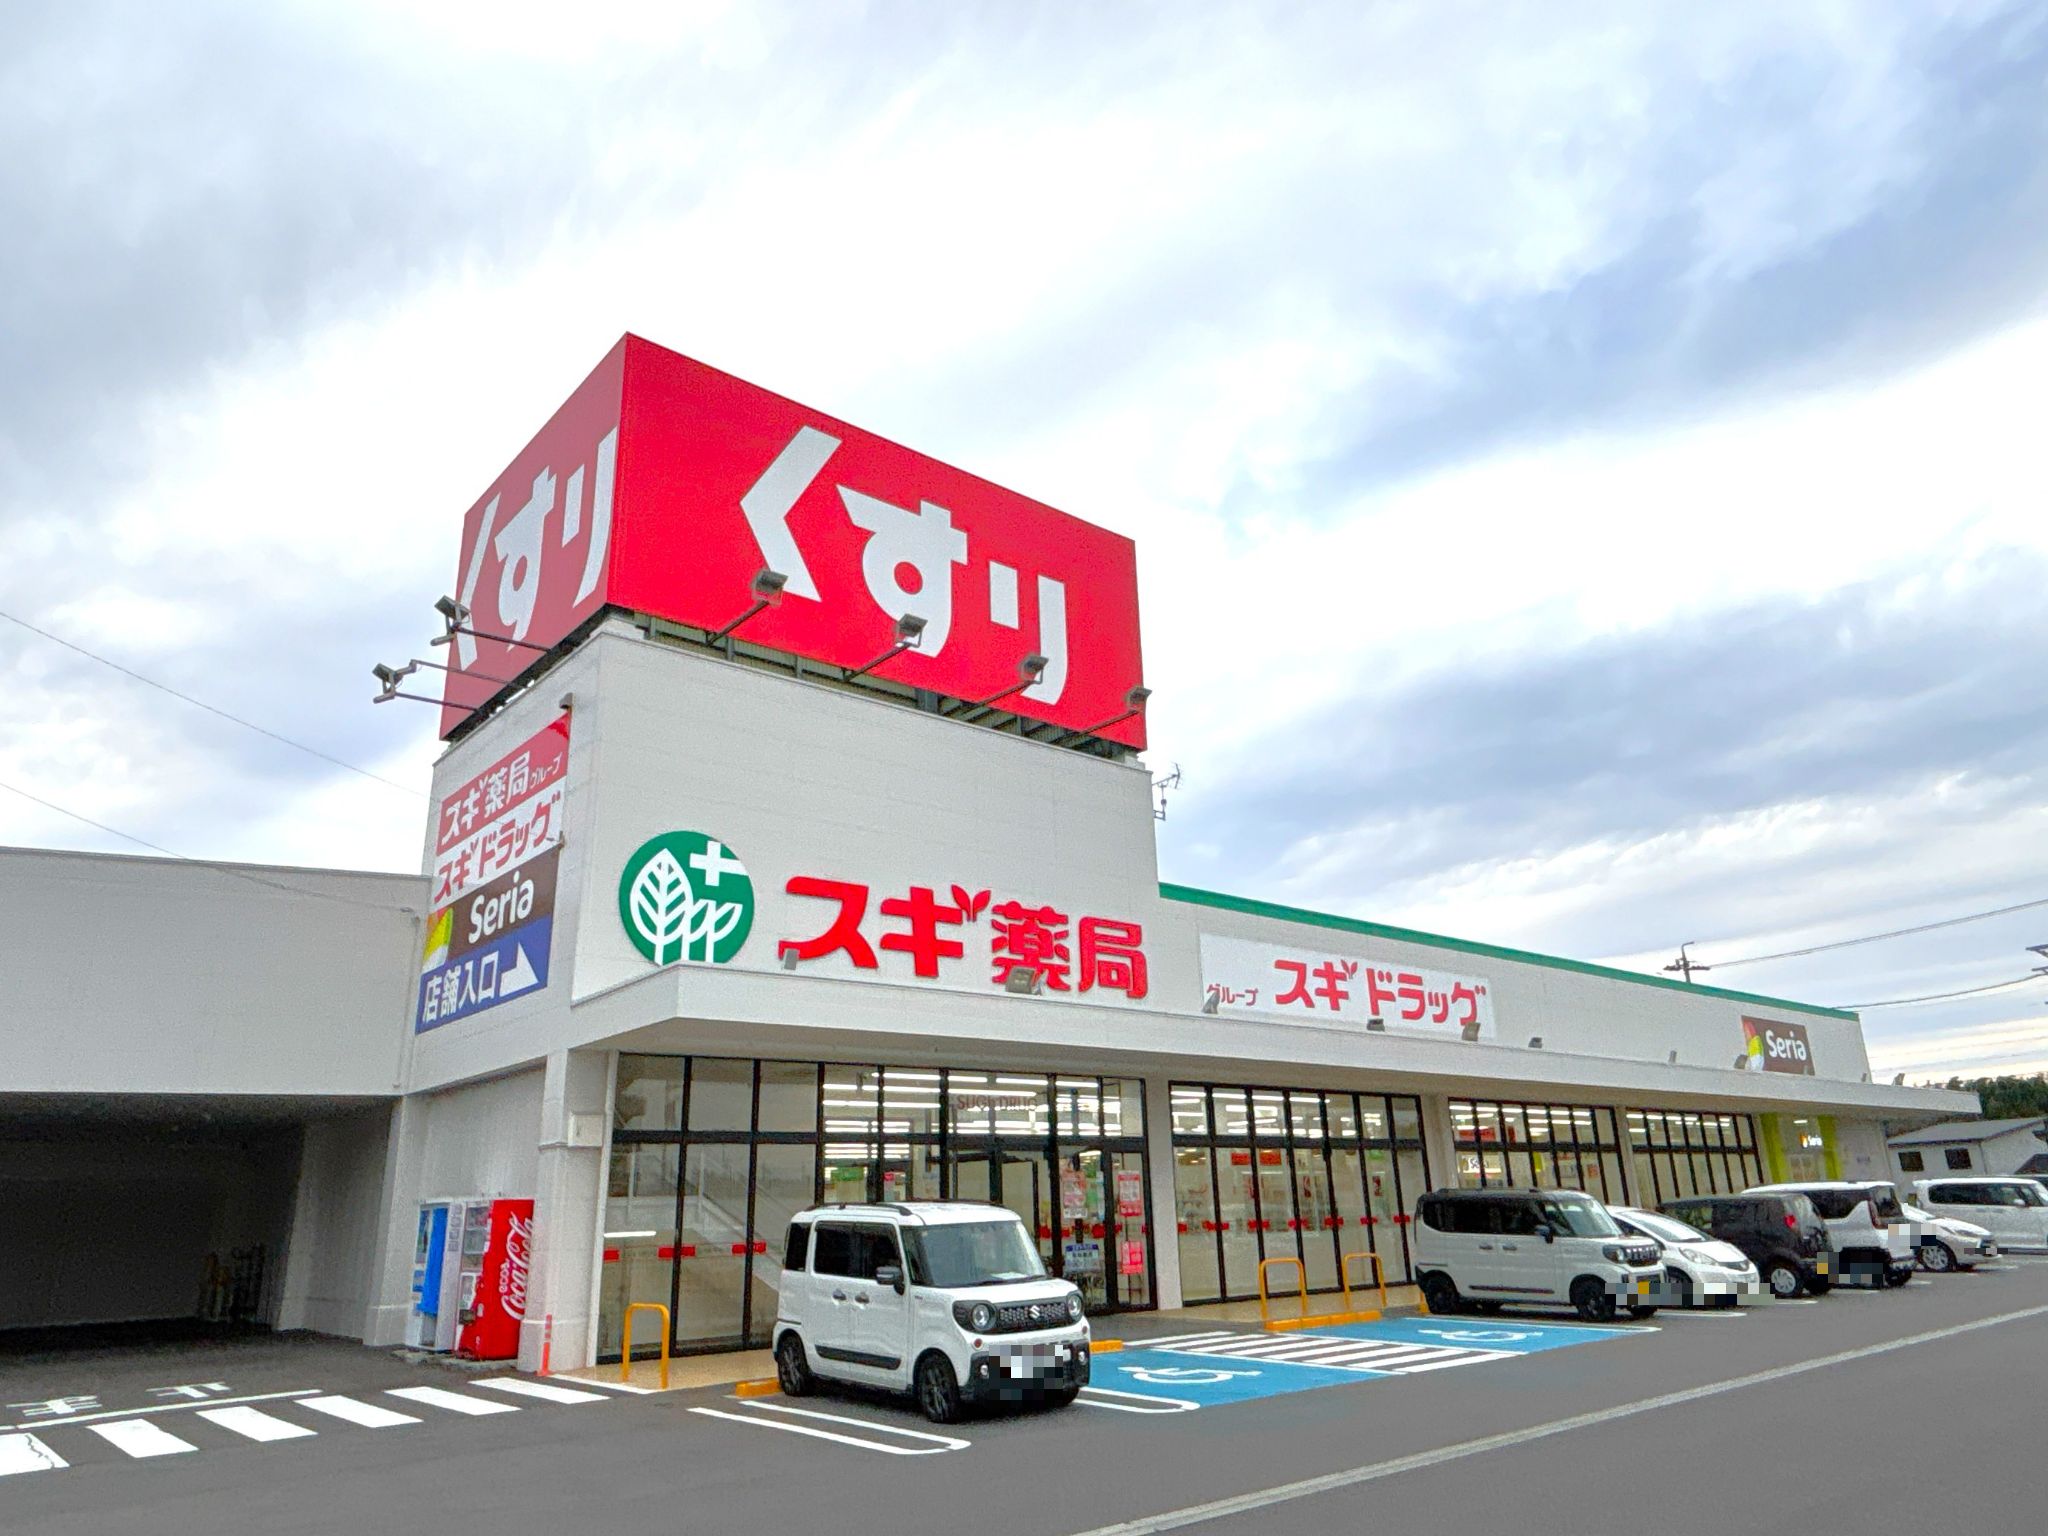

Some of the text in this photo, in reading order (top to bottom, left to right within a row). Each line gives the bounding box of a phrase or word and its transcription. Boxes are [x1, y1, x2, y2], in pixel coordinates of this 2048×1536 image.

[455, 425, 618, 671] くすり
[740, 424, 1068, 706] くすり
[441, 751, 531, 846] スギ薬局
[434, 790, 561, 904] スギドラッグ
[469, 870, 534, 944] Seria
[778, 875, 1148, 999] スギ薬局
[422, 950, 499, 1025] 店舗入口
[1206, 959, 1487, 1027] グループ スギドラッグ
[1765, 1029, 1807, 1061] Seria
